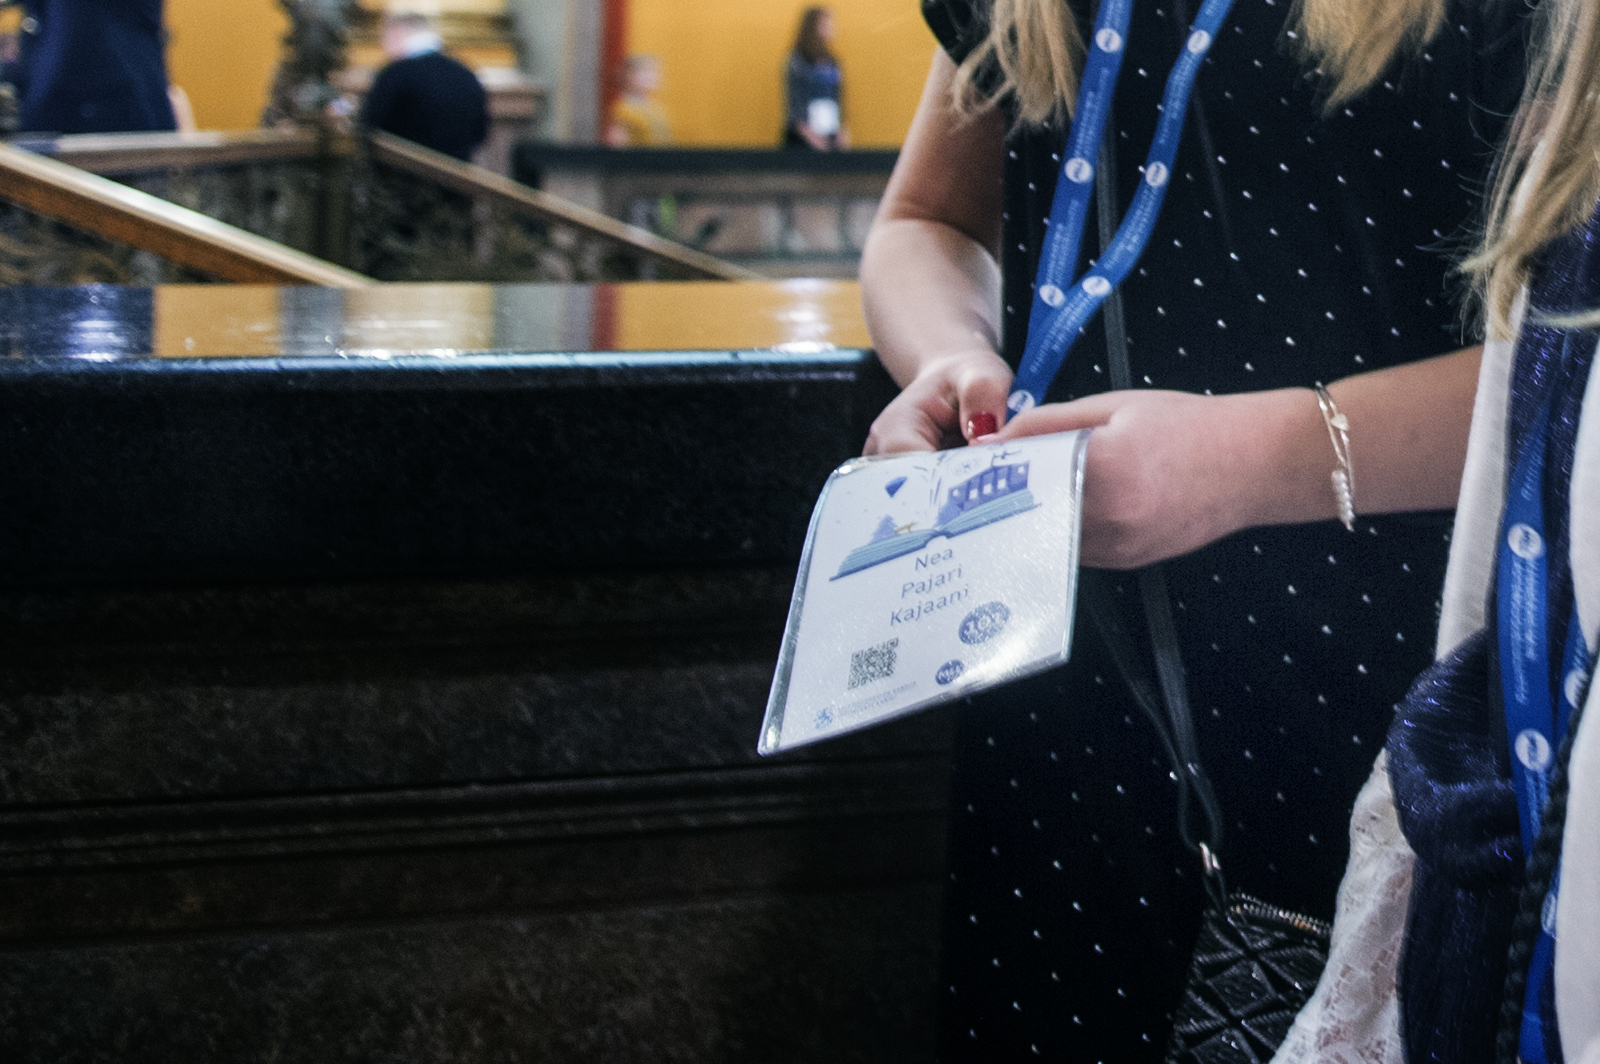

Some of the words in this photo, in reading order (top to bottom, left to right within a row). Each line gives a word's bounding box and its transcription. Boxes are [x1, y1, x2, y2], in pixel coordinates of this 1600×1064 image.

[914, 549, 953, 570] Nea
[901, 566, 963, 599] Pajari
[890, 586, 969, 625] Kajaani
